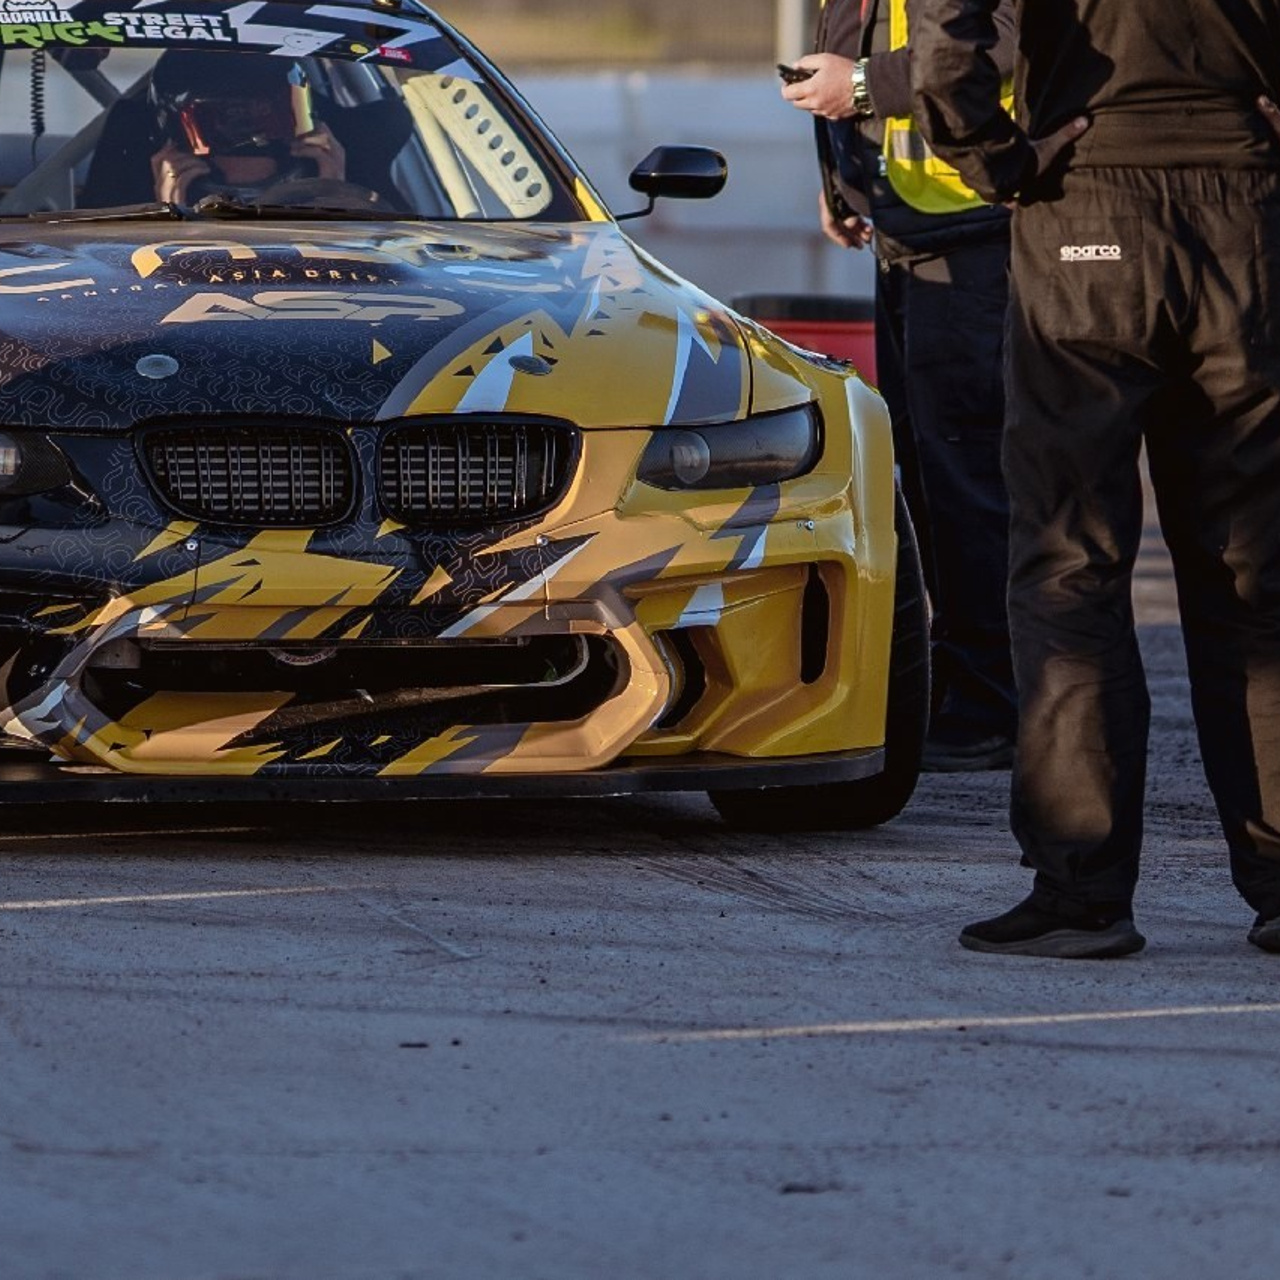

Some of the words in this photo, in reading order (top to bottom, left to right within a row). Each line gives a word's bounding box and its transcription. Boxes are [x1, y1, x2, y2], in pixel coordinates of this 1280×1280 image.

[103, 13, 222, 27] STREET
[126, 26, 232, 41] LEGAL
[209, 269, 286, 283] ASIA
